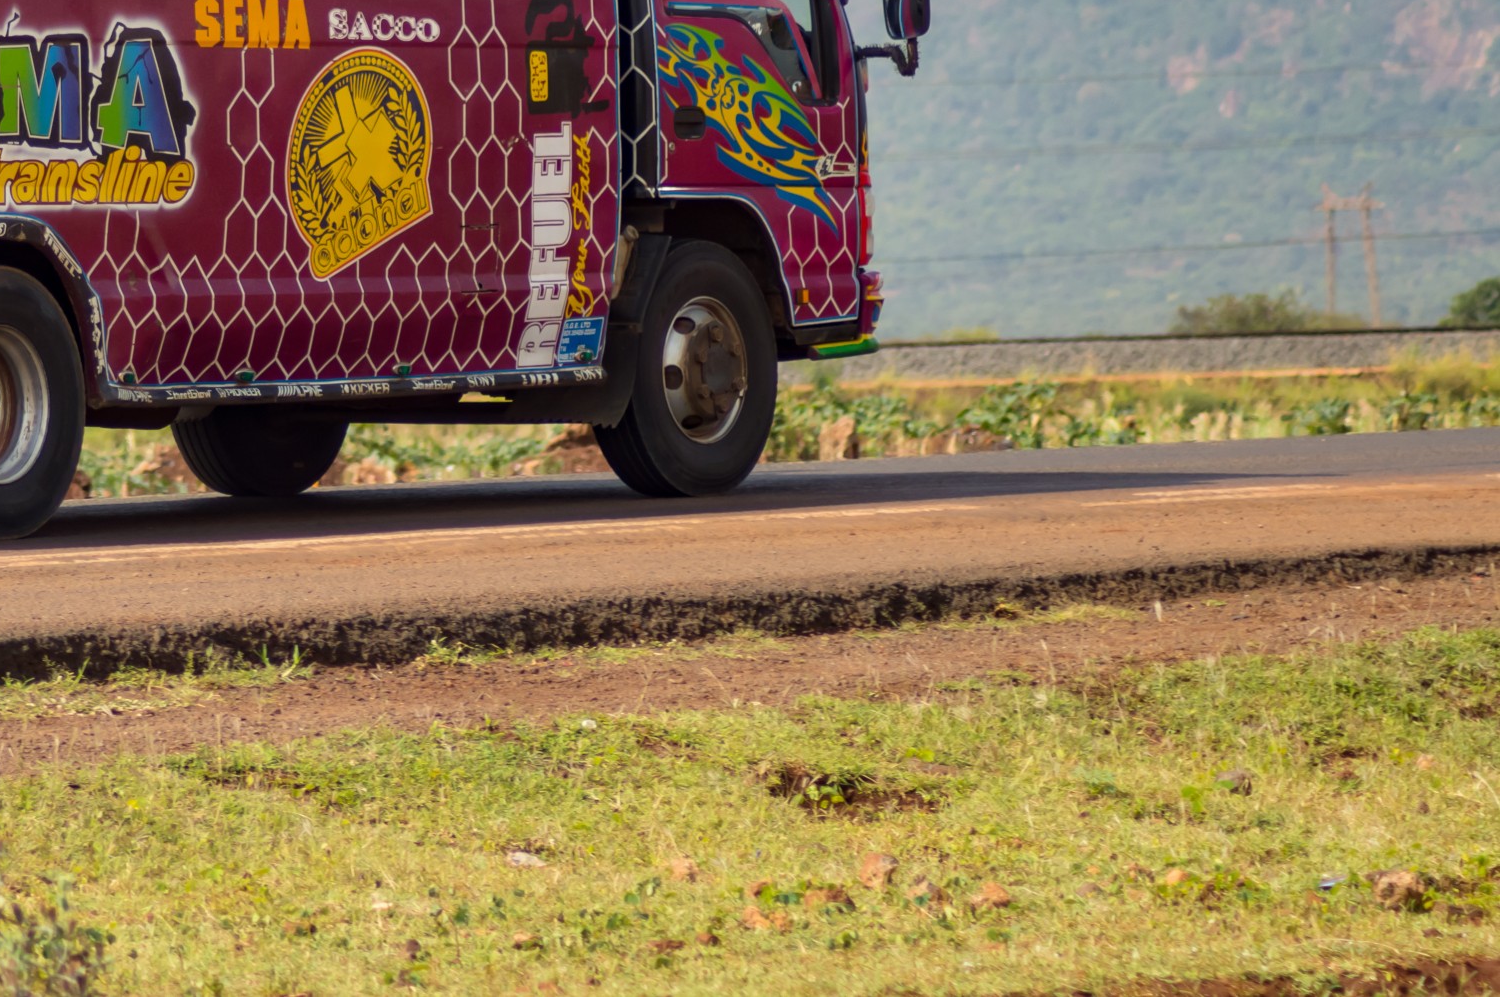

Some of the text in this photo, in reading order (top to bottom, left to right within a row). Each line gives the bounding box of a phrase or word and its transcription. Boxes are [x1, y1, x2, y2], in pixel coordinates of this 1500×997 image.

[328, 8, 441, 42] SACCO
[516, 121, 572, 370] REFUEL
[226, 387, 262, 397] PIONEER
[350, 382, 390, 395] KICKER
[467, 375, 495, 388] SONY
[573, 368, 604, 382] SONY
